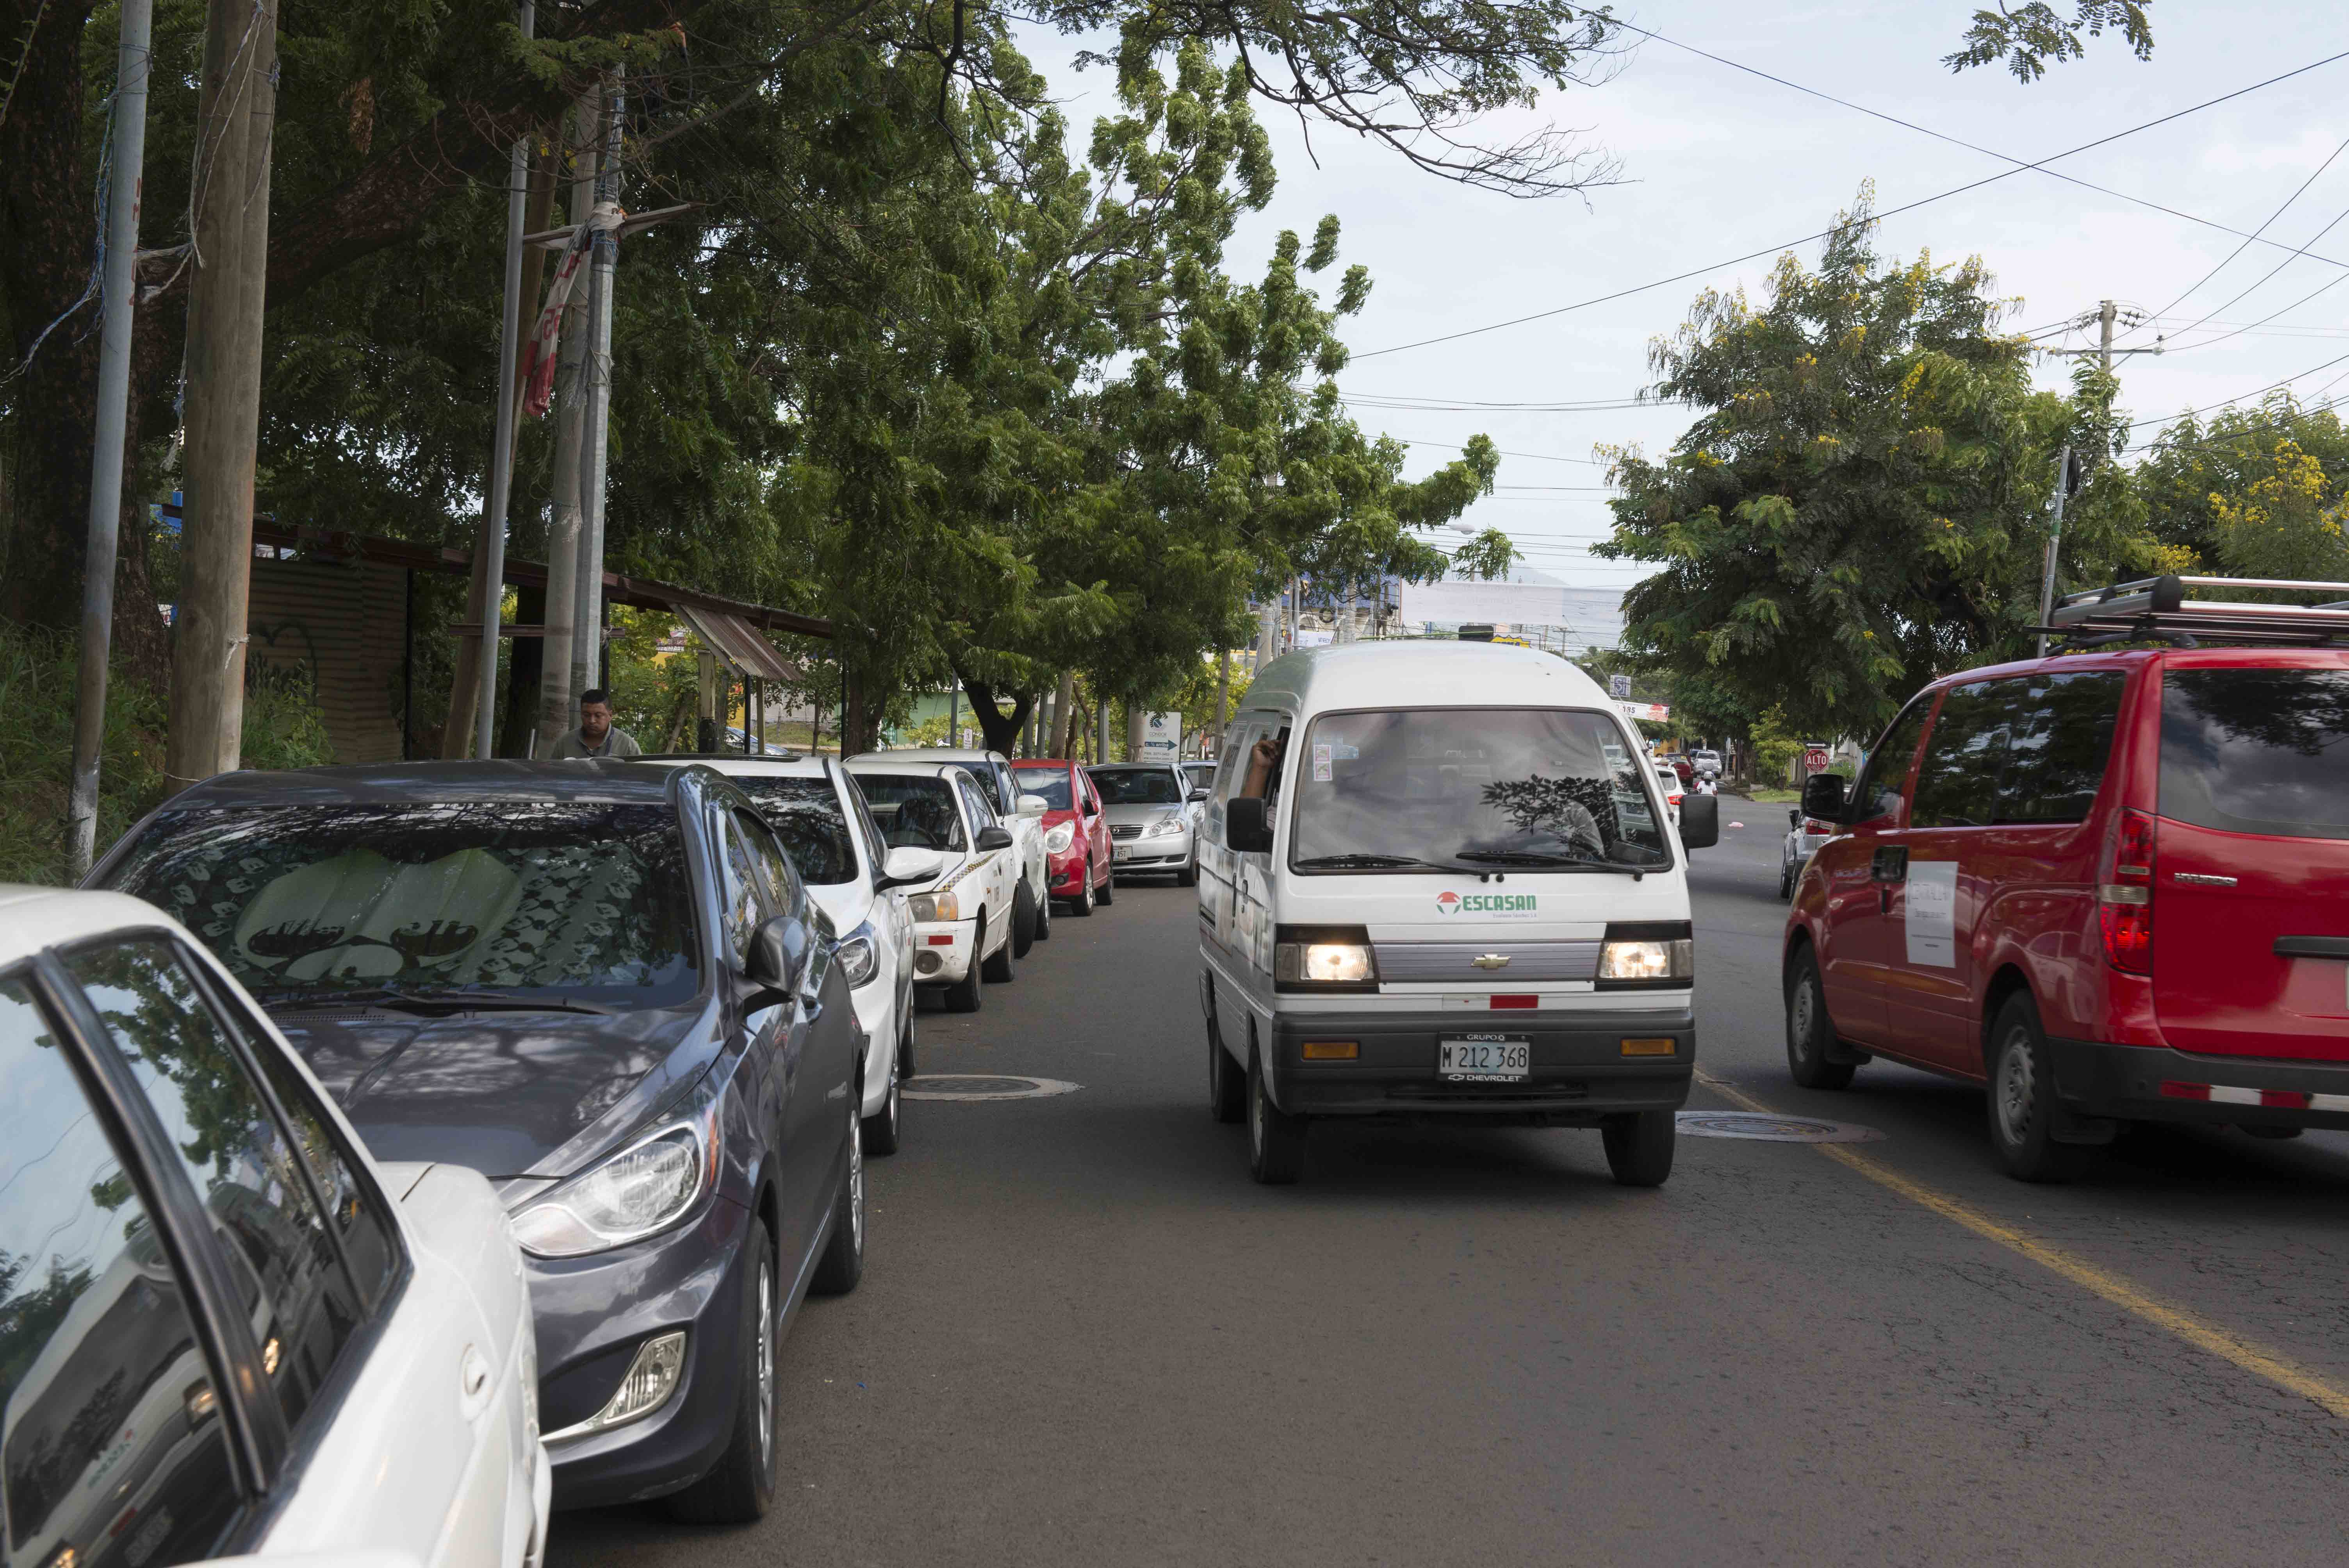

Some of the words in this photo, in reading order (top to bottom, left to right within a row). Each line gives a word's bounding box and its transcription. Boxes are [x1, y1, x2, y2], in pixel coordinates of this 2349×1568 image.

[1806, 755, 1827, 765] ALTO
[1463, 895, 1536, 911] ESCASAN
[1442, 1046, 1452, 1068] M
[1458, 1046, 1490, 1068] 212
[1496, 1046, 1527, 1068] 368
